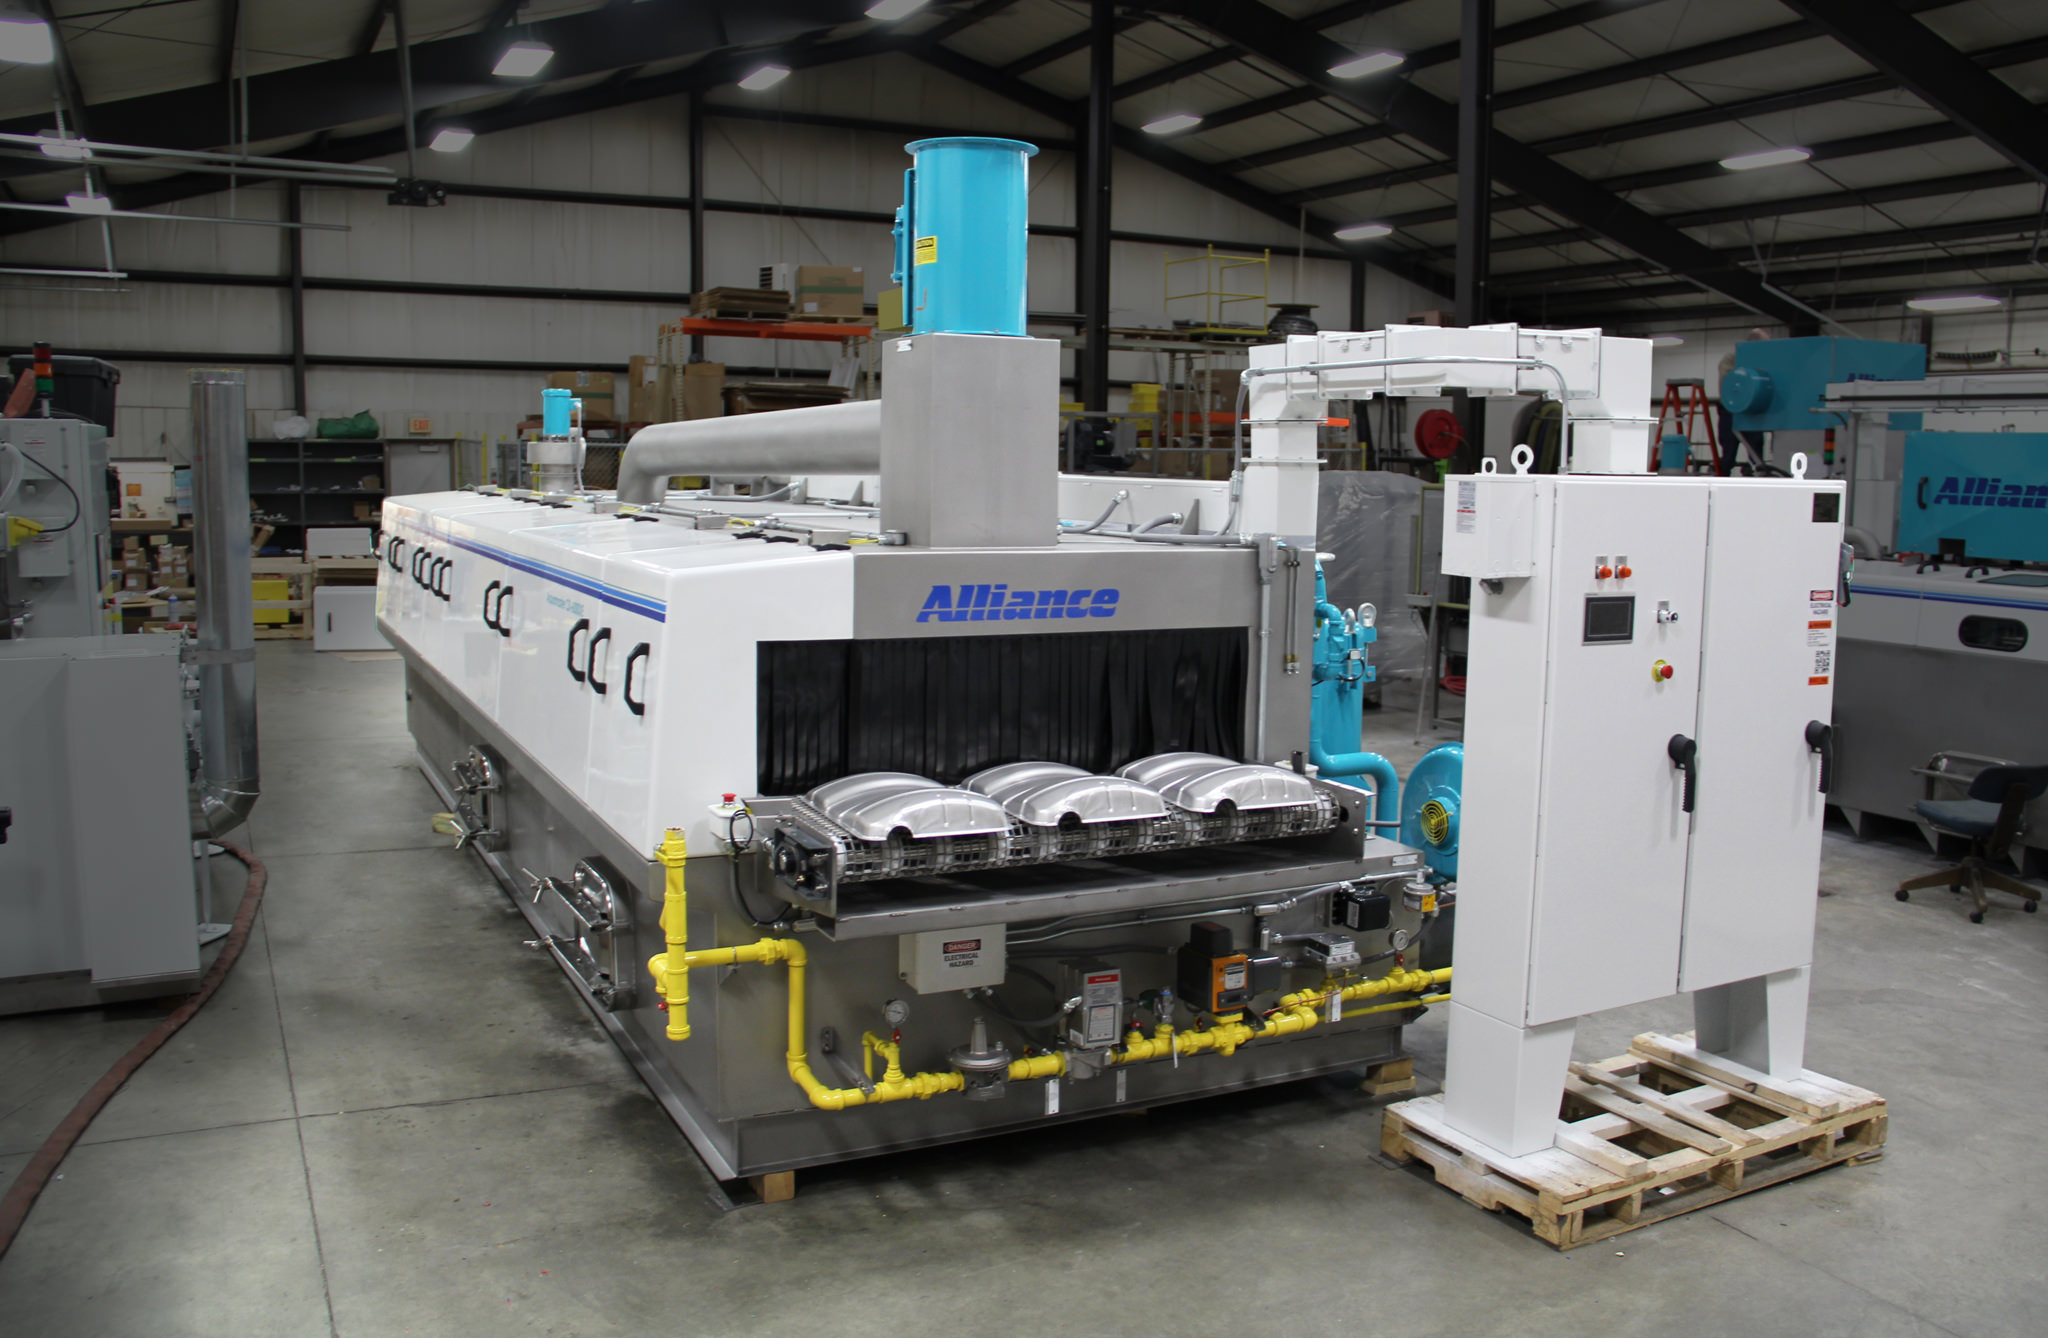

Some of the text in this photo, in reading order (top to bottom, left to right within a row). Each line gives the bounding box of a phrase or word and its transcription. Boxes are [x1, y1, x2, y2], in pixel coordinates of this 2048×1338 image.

[915, 583, 1121, 623] Alliance
[948, 942, 977, 951] DANGER
[944, 952, 979, 961] ELECTRICAL
